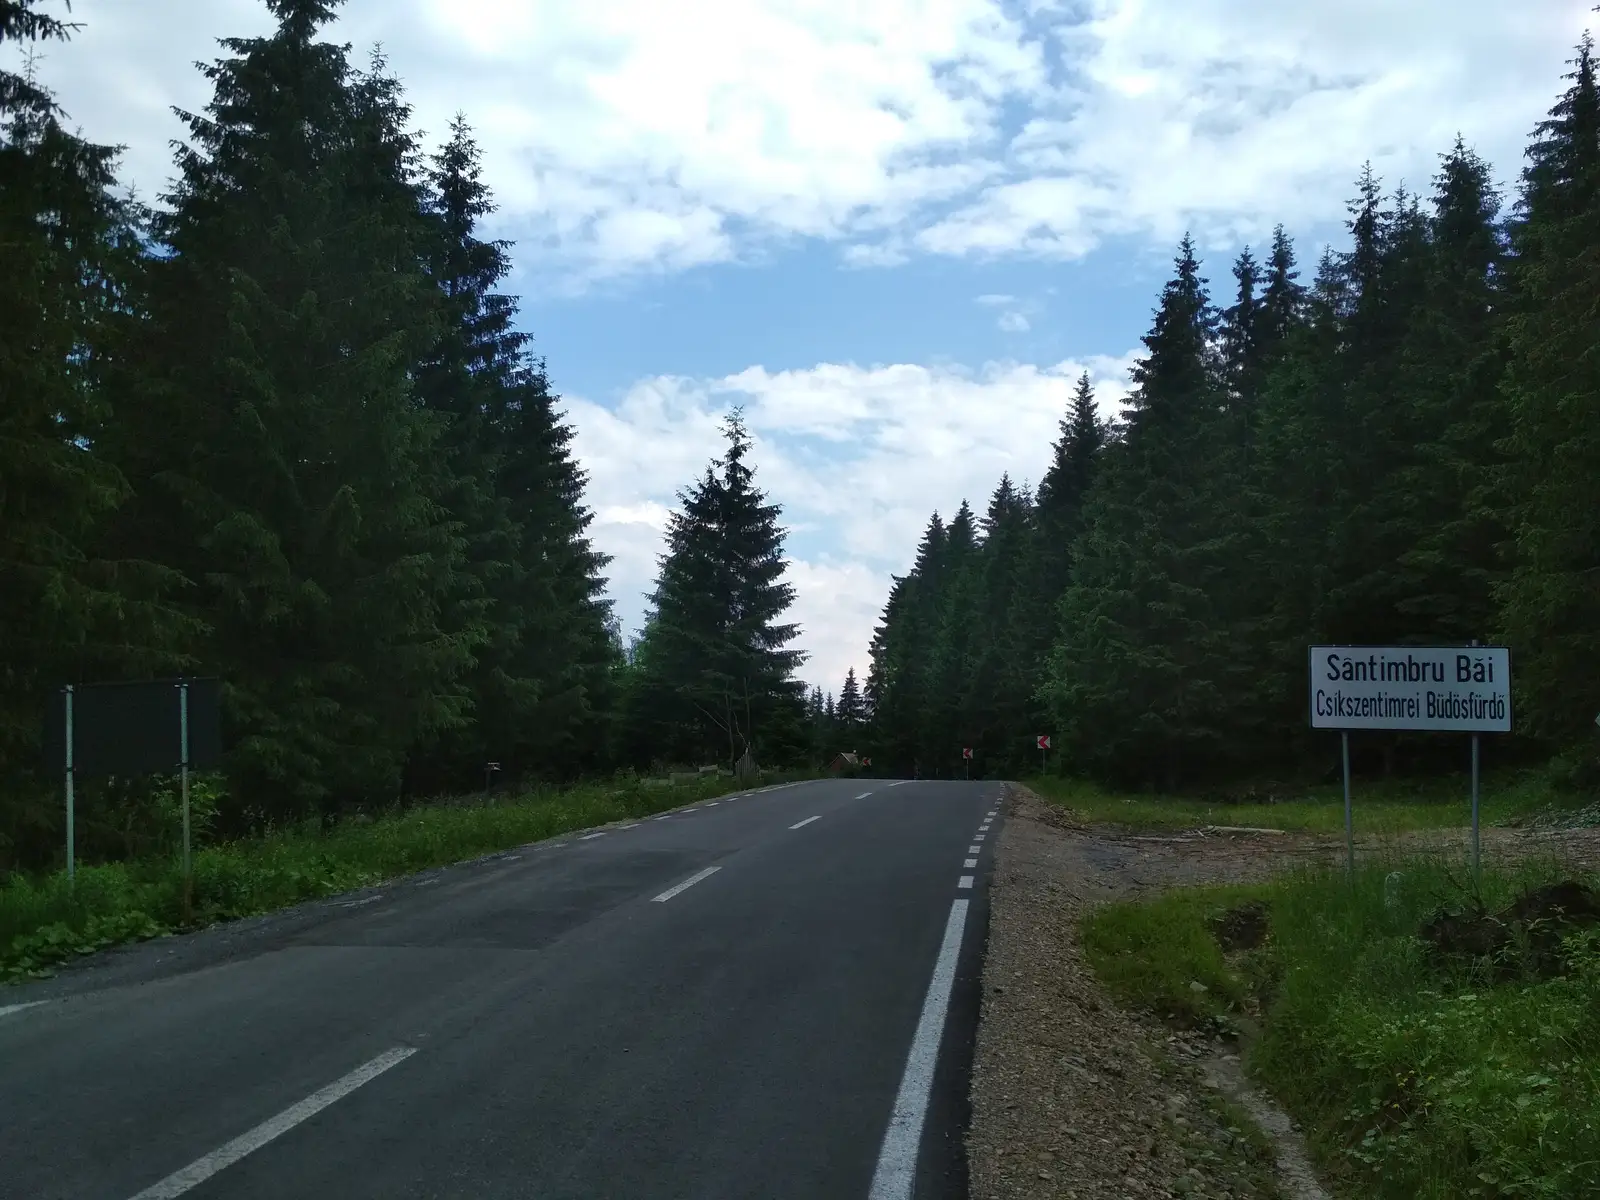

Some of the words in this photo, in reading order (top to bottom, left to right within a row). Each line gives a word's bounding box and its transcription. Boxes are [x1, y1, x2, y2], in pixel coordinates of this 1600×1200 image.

[1327, 654, 1445, 683] Sântimbru
[1456, 655, 1494, 683] Băi
[1316, 689, 1420, 719] Csíkszentimrei
[1427, 691, 1505, 720] Büdösfürdő
